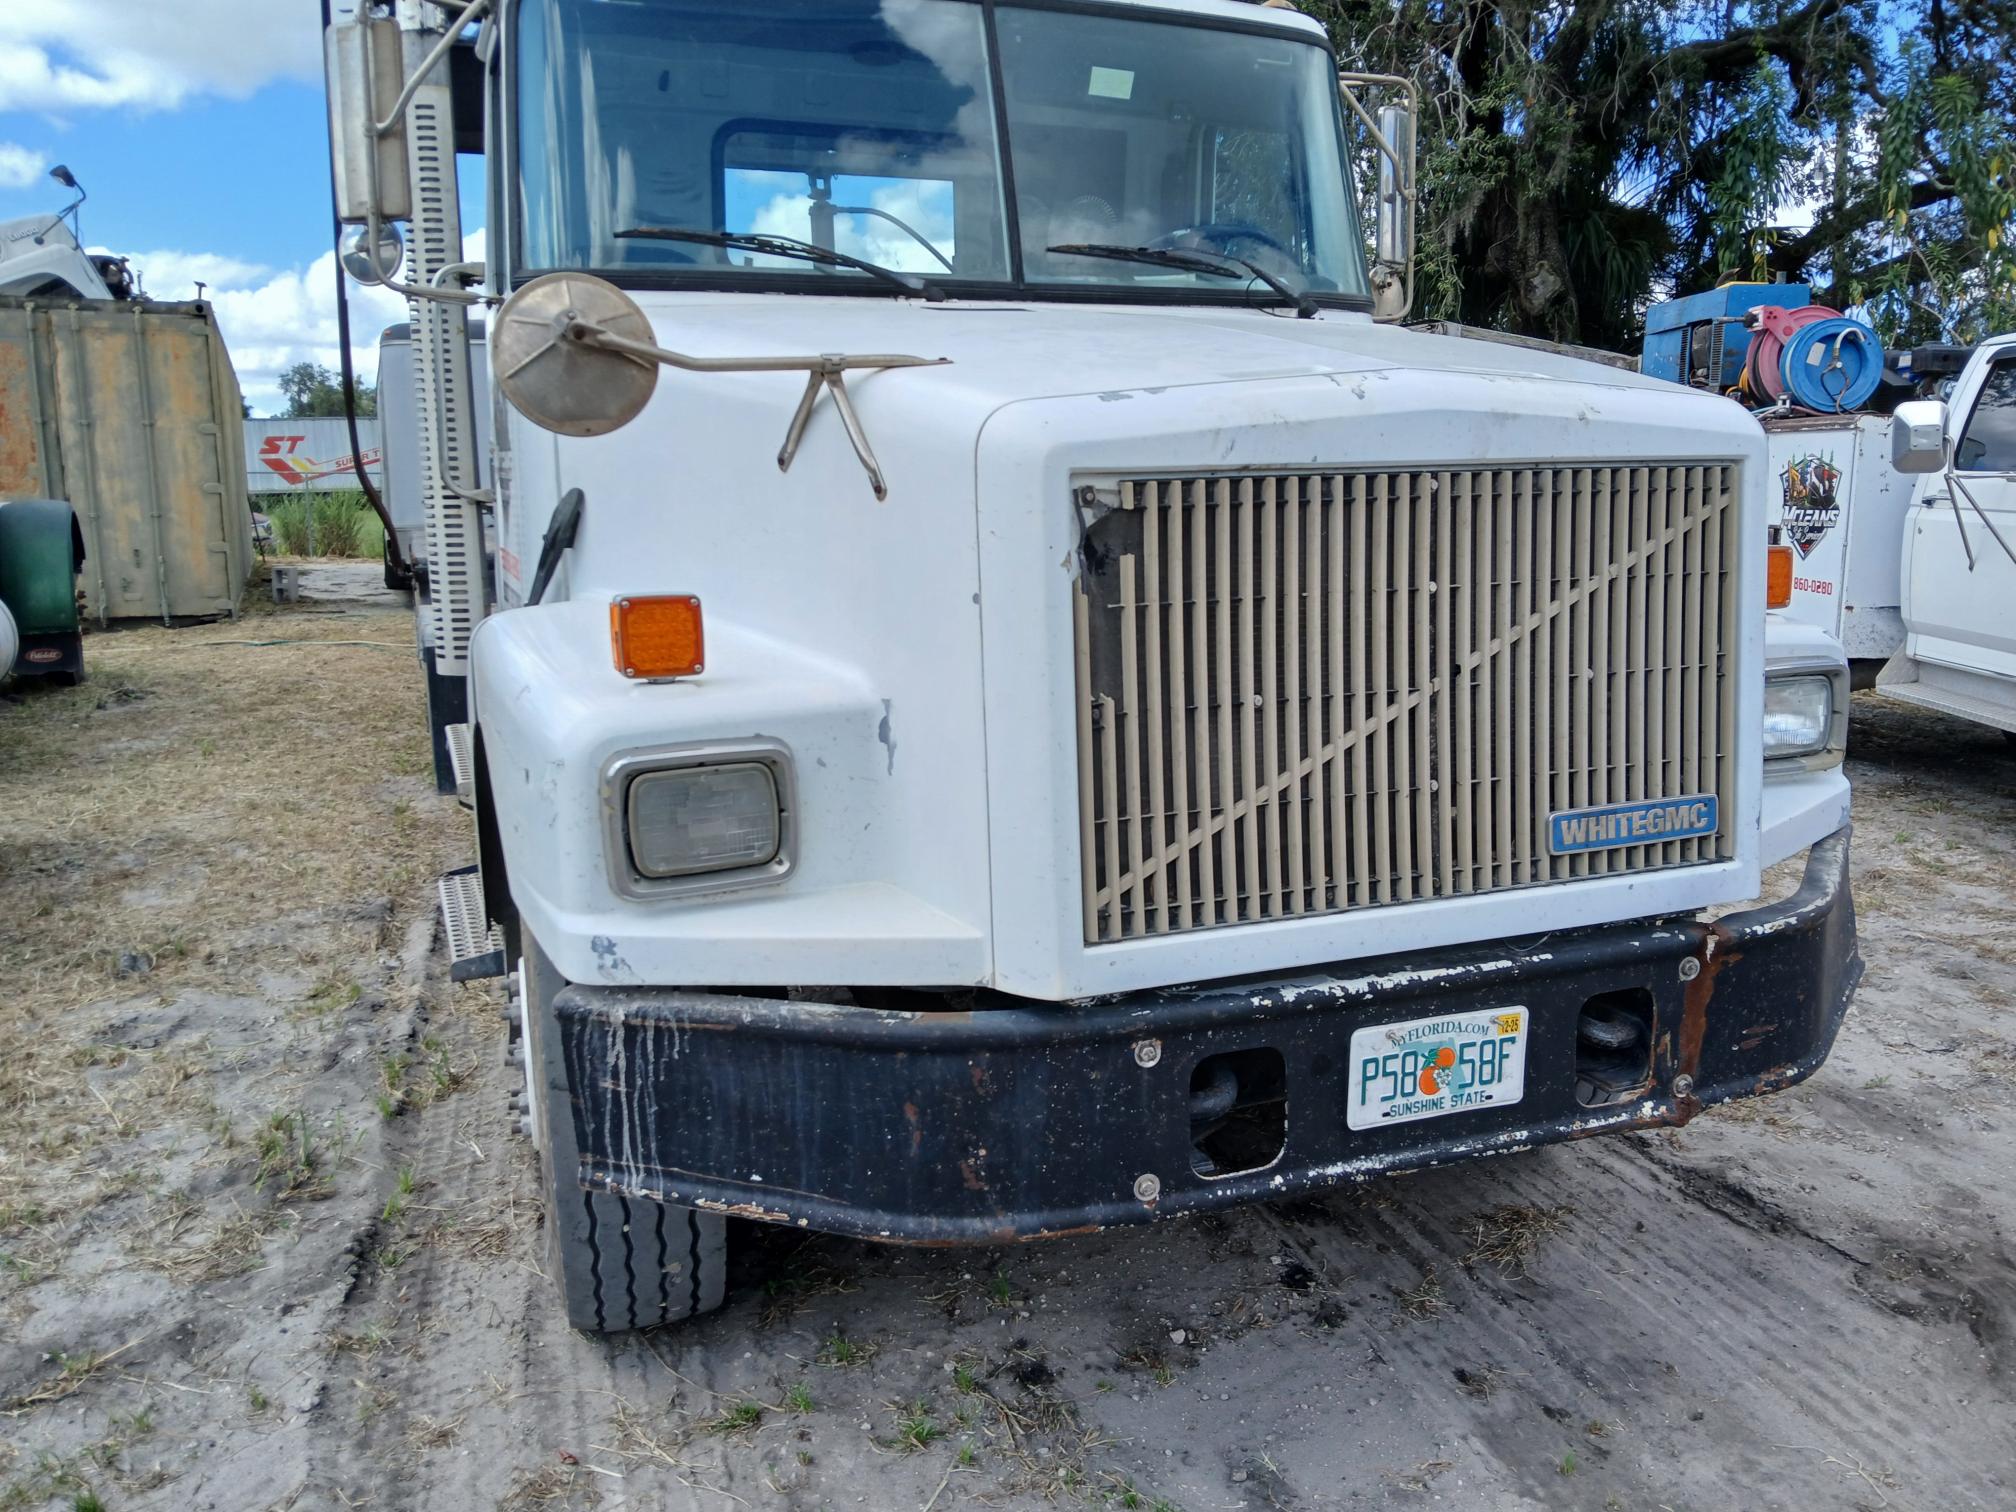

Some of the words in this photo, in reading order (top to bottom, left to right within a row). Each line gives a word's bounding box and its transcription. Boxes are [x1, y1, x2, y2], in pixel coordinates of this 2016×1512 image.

[259, 435, 305, 455] ST
[335, 452, 369, 468] SUPR
[1793, 576, 1833, 595] 860-0280
[1560, 802, 1709, 846] WHITEGMC
[1360, 1050, 1419, 1106] P58
[1458, 1036, 1517, 1089] 58F
[1389, 1095, 1446, 1118] SUNSHINE
[1450, 1089, 1487, 1108] STATE
